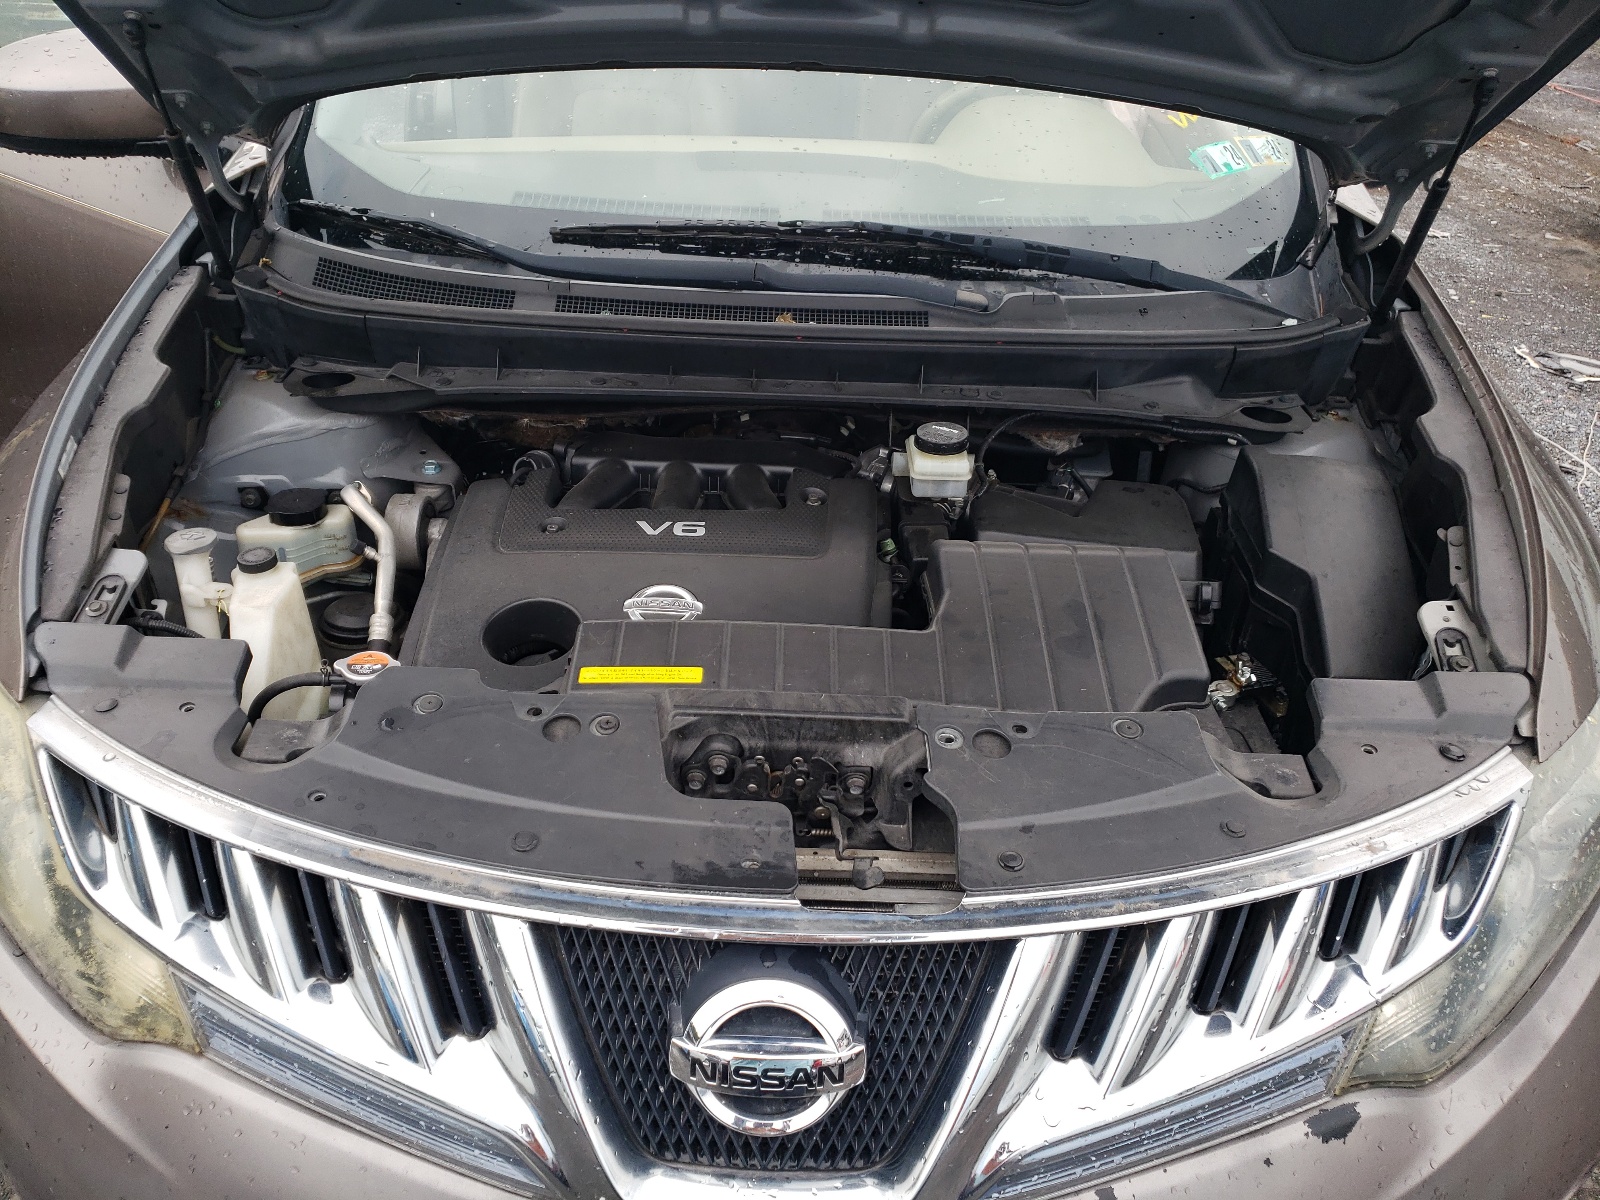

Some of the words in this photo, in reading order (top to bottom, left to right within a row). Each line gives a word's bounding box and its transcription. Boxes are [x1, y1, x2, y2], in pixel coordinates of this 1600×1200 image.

[636, 521, 706, 537] V6
[632, 600, 695, 609] NISSAN
[690, 1056, 845, 1091] NISSAN
